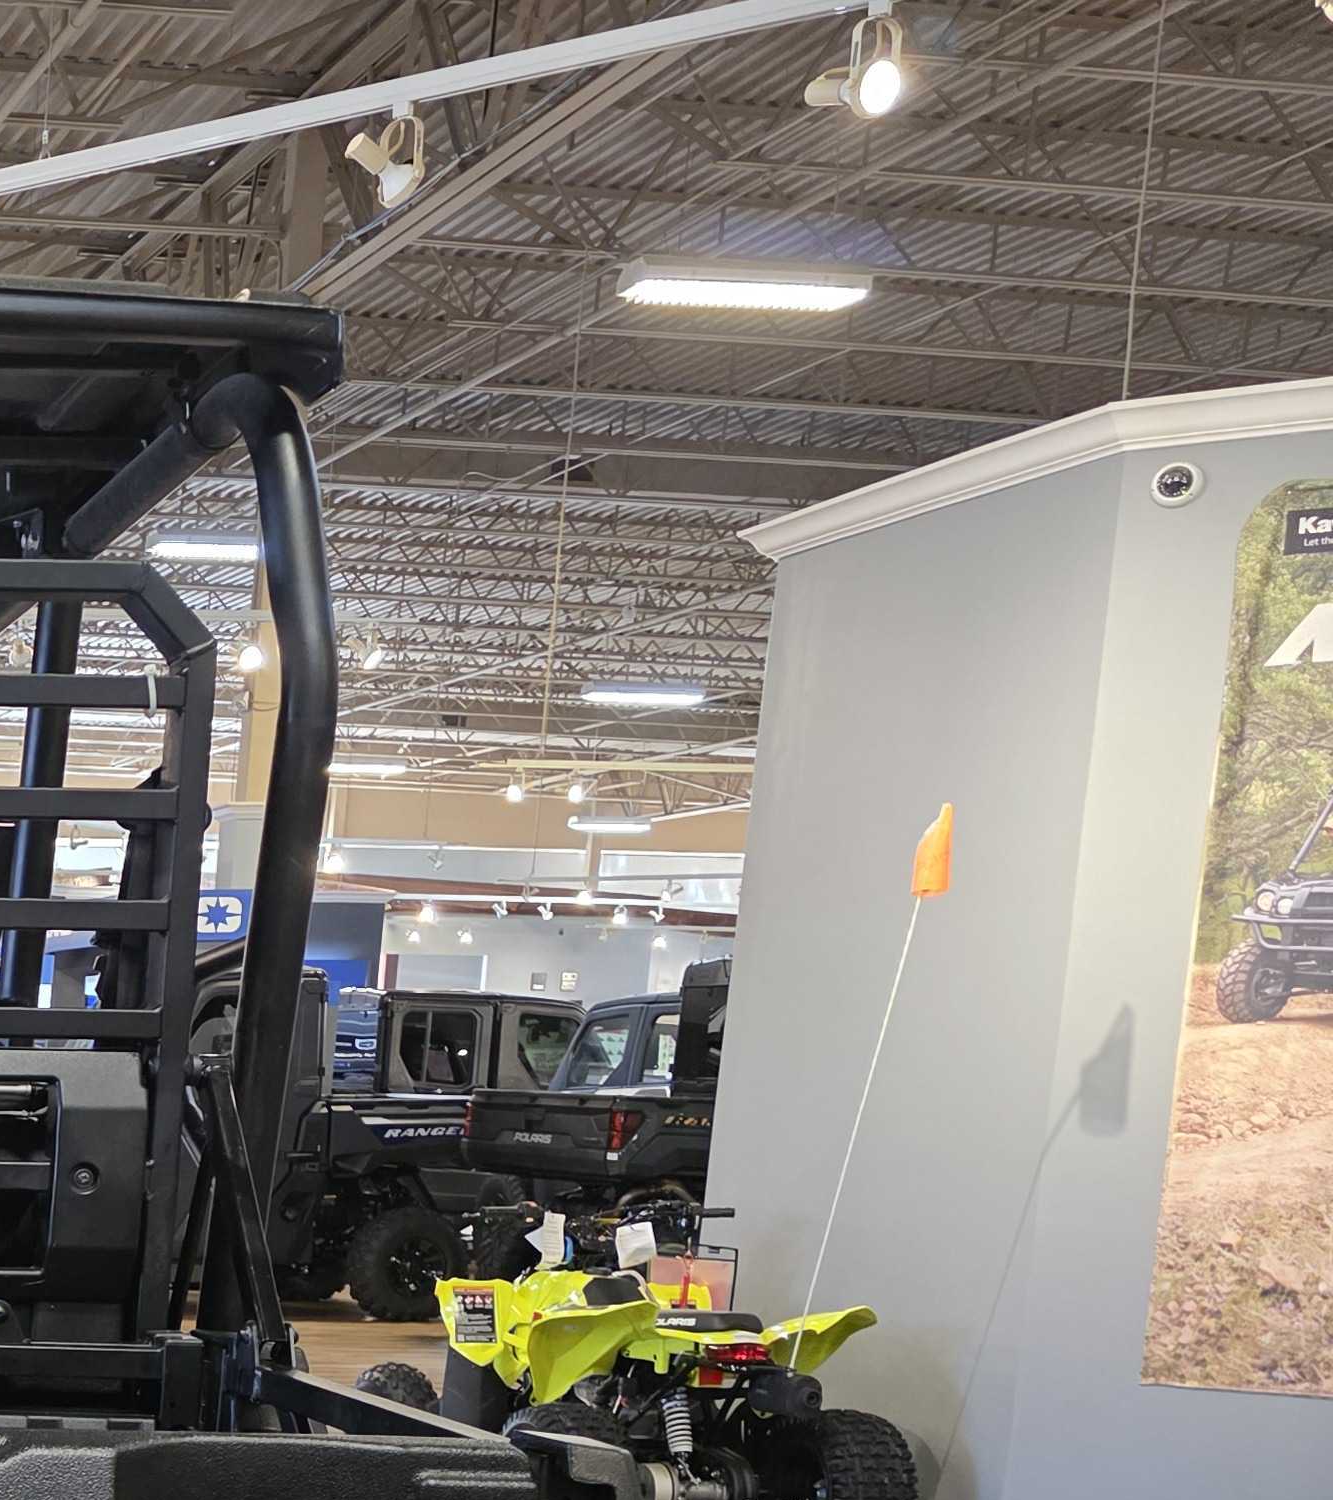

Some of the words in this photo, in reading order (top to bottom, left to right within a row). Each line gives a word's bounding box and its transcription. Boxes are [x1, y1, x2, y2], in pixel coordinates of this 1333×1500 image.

[1298, 516, 1333, 535] Ka
[513, 1132, 553, 1144] POLARIS
[655, 1317, 696, 1327] OLARIS
